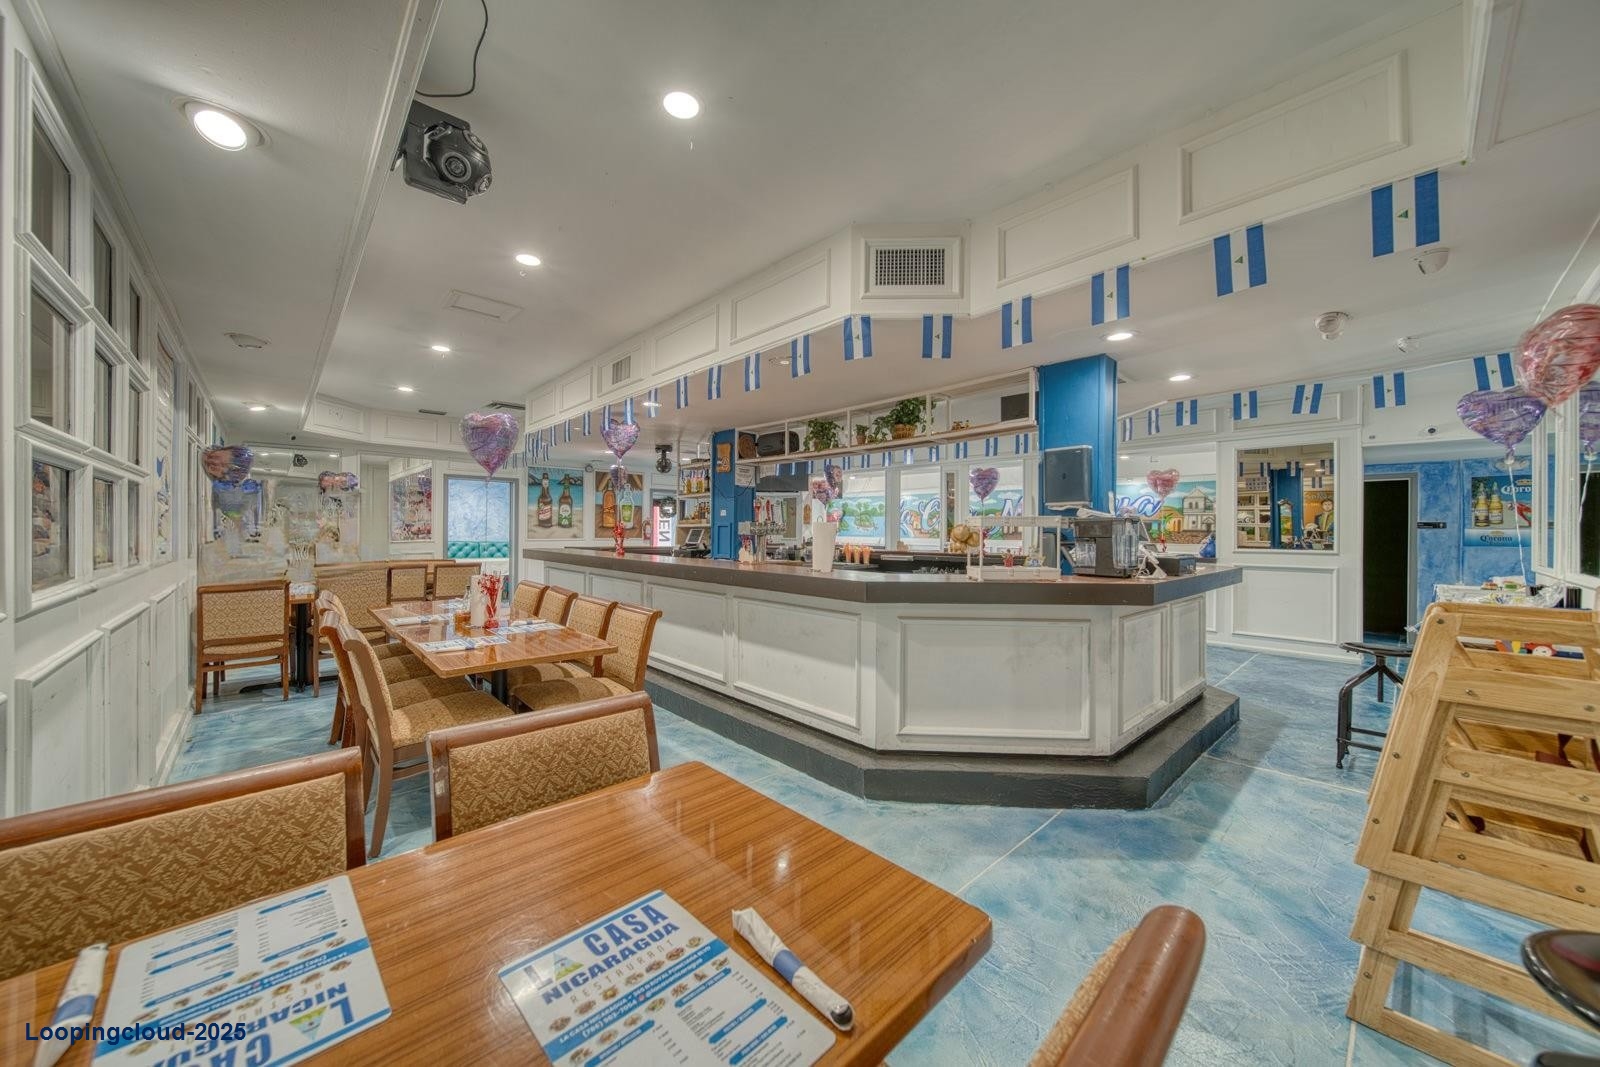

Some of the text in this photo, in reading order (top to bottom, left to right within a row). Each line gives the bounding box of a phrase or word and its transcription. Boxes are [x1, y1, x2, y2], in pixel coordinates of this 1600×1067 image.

[1500, 485, 1531, 496] Coro
[583, 904, 669, 956] CASA
[541, 922, 680, 1005] NICARAGUA
[570, 938, 675, 1004] RESTAURANT
